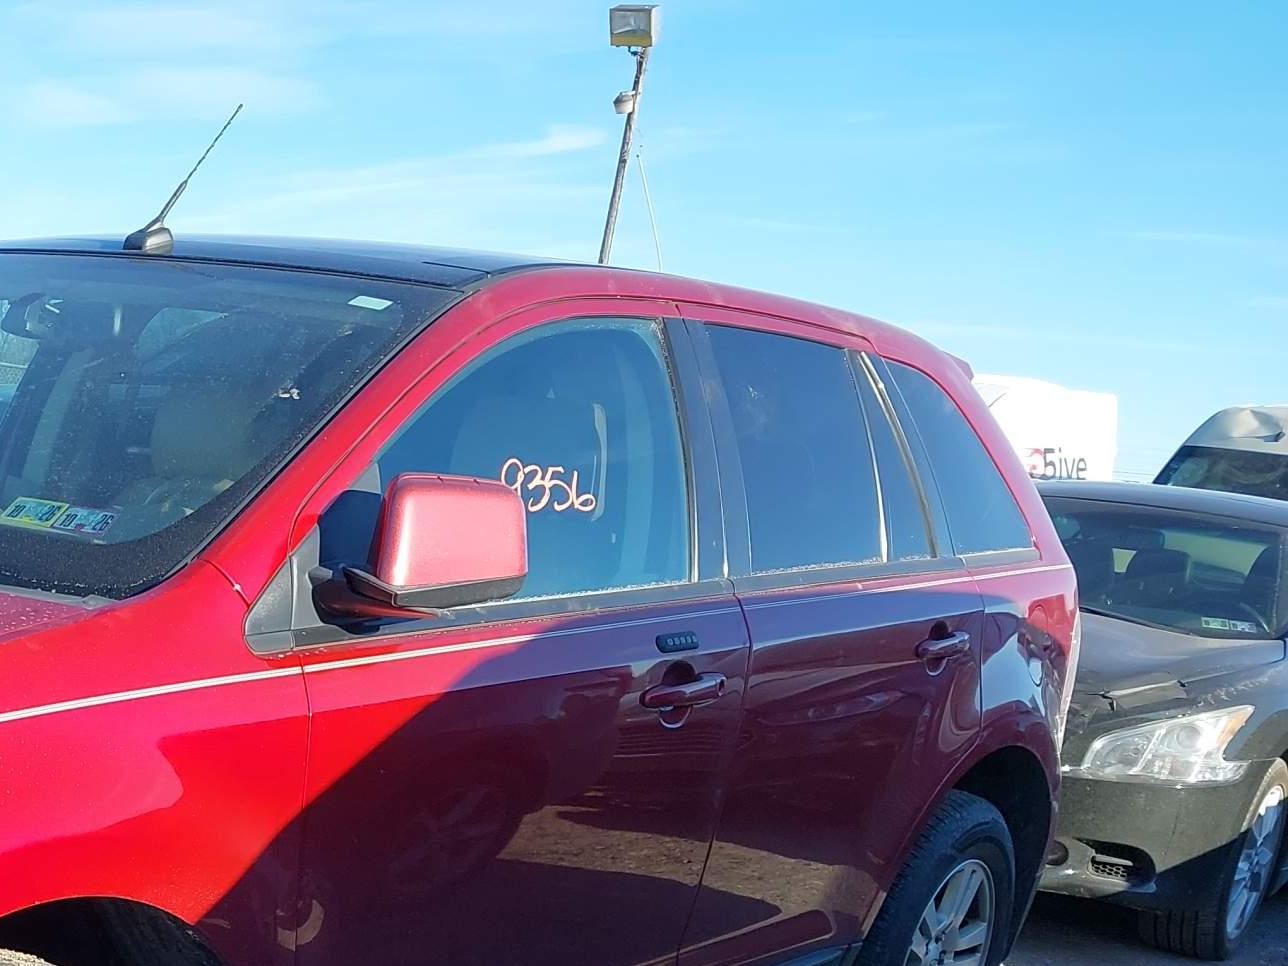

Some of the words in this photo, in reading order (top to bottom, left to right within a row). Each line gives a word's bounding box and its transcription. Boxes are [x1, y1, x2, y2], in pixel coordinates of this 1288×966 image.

[501, 458, 596, 512] 9356
[8, 504, 26, 518] 10
[93, 513, 114, 531] 26
